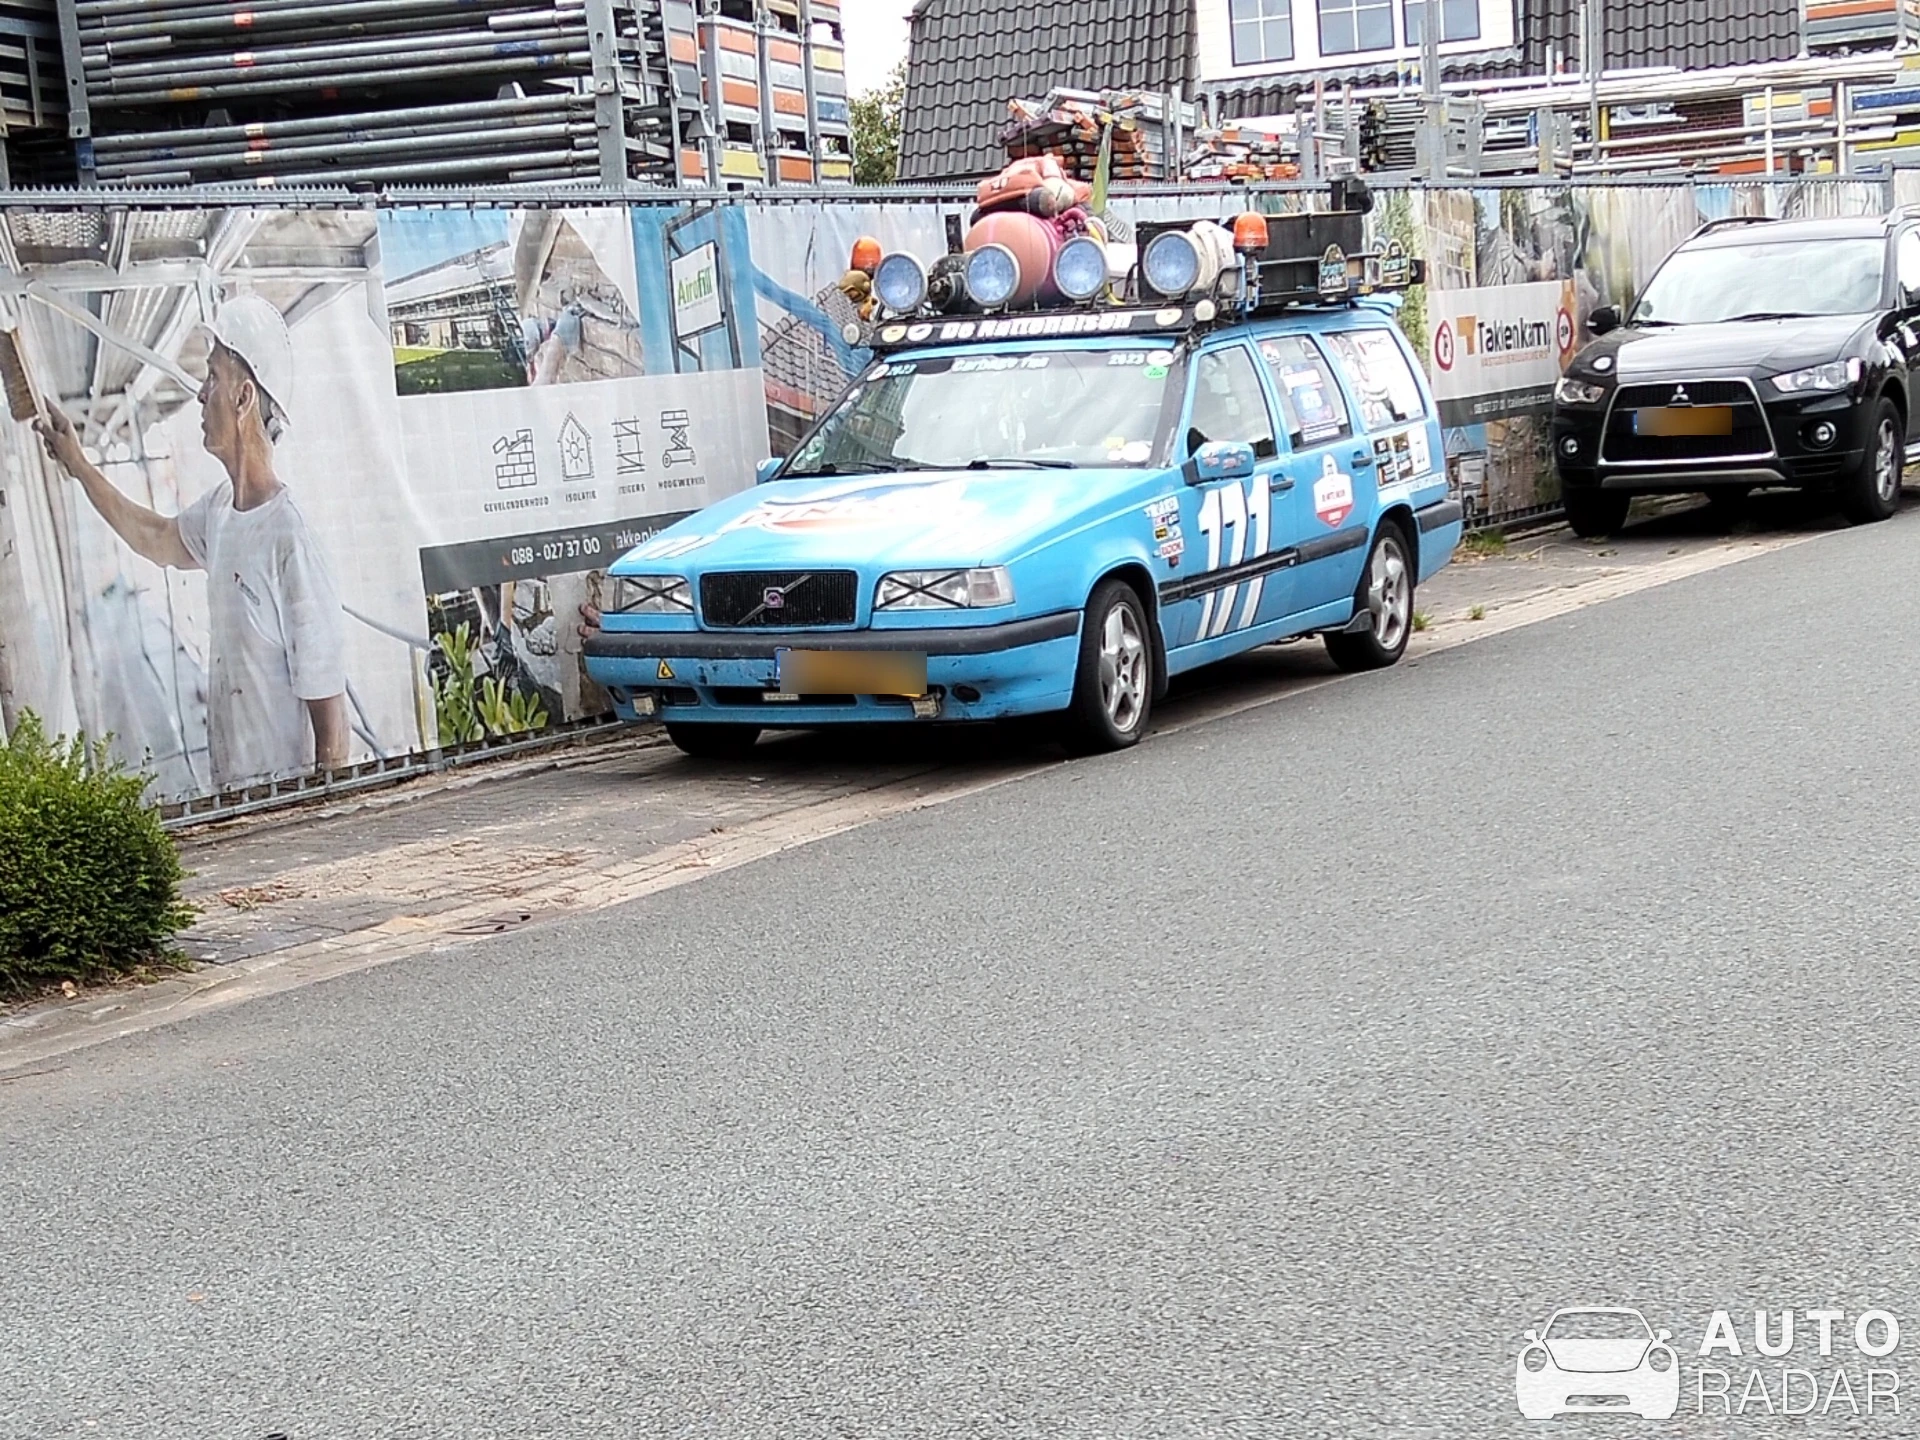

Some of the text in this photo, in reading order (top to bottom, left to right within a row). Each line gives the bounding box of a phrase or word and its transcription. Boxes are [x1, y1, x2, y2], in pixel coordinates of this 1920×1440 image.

[565, 490, 597, 503] ISOLATIE
[511, 546, 534, 565] 088
[543, 542, 564, 561] 027
[565, 539, 580, 558] 37
[583, 536, 600, 555] 00
